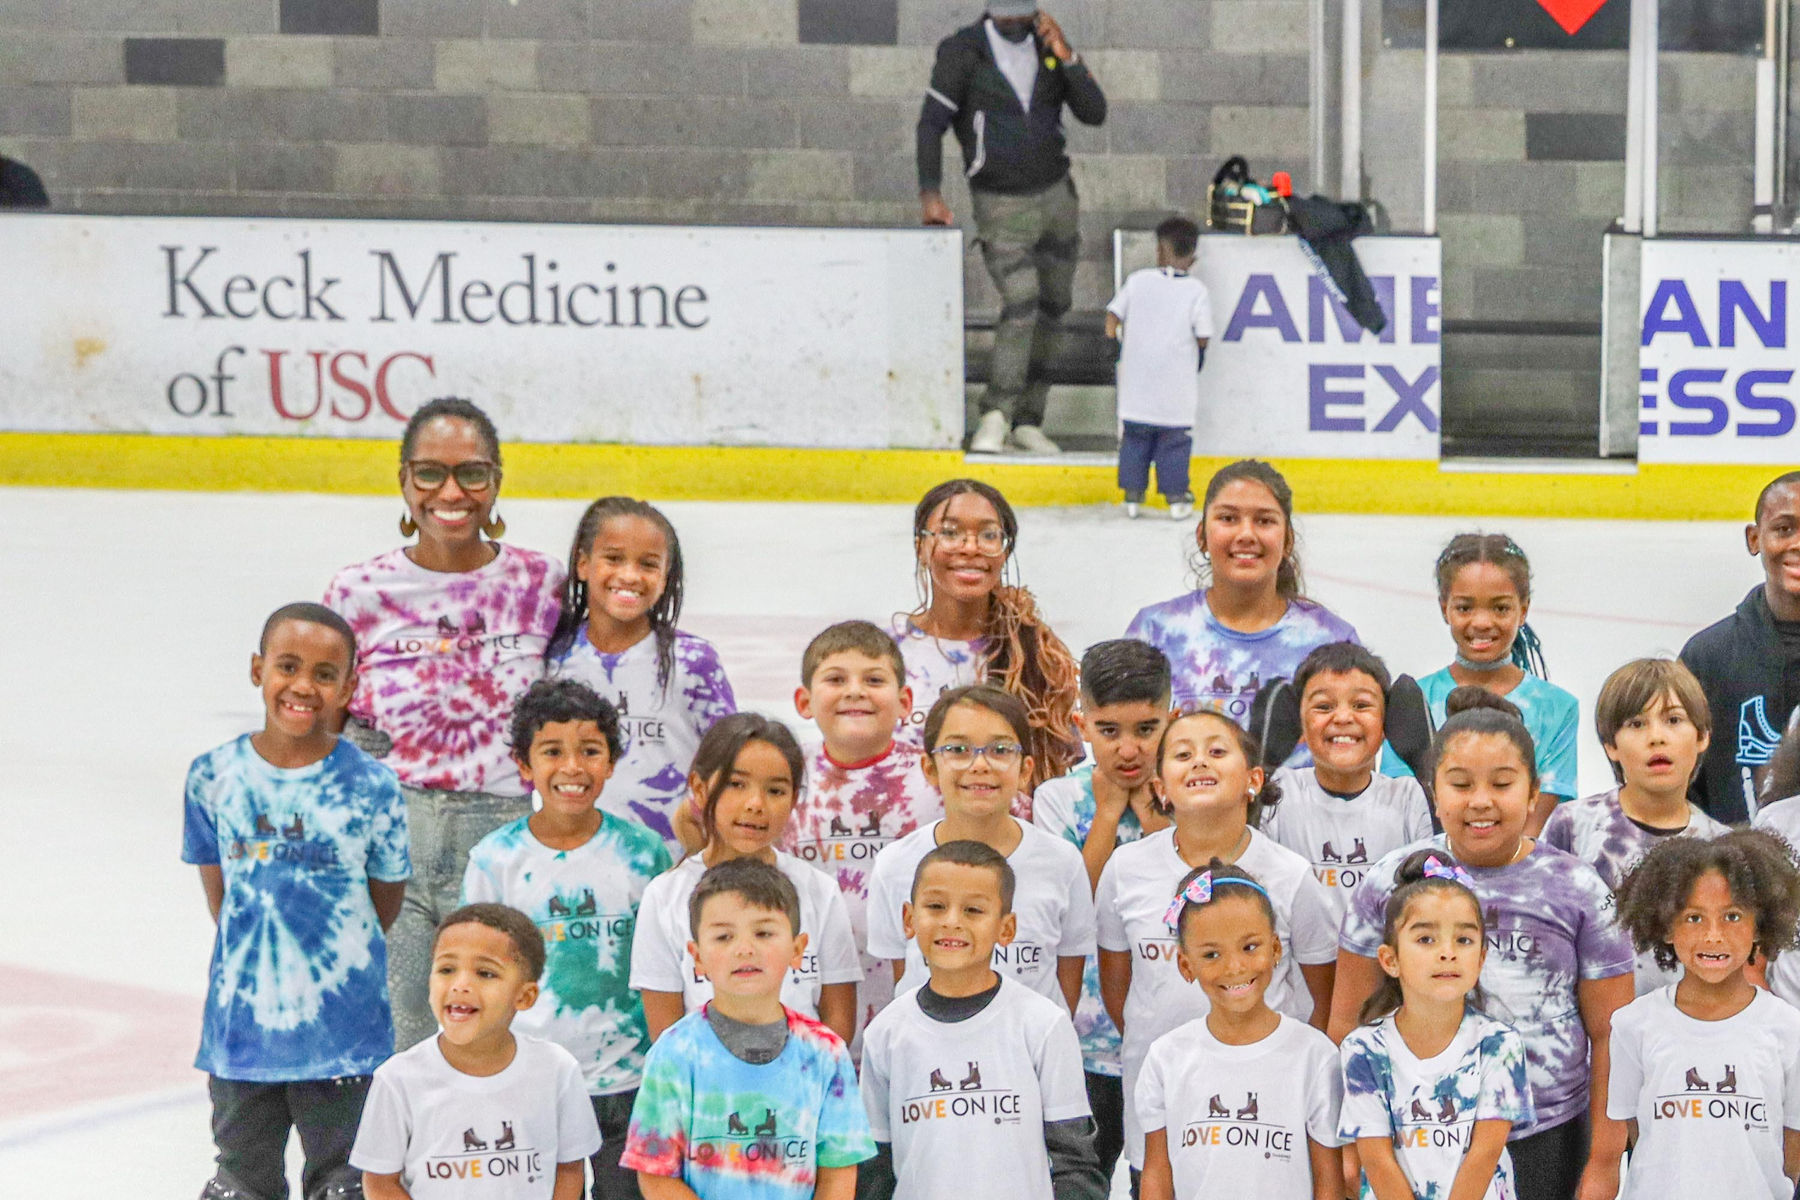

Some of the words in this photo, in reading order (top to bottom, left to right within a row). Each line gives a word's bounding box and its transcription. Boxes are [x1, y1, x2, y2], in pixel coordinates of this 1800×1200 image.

[158, 245, 346, 321] Keck
[369, 250, 710, 330] Medicine
[1641, 278, 1788, 349] AN
[166, 345, 245, 419] of
[260, 348, 437, 422] USC
[1308, 364, 1439, 433] EX
[490, 633, 521, 650] ICE
[637, 721, 665, 739] ICE
[794, 841, 847, 863] LOVE
[850, 842, 885, 861] ON
[569, 918, 600, 940] ON
[607, 917, 634, 938] ICE
[1015, 945, 1043, 965] ICE
[1509, 934, 1543, 954] ICE
[902, 1099, 947, 1124] LOVE
[951, 1097, 986, 1116] ON
[993, 1095, 1021, 1114] ICE
[1654, 1098, 1703, 1120] LOVE
[1708, 1099, 1741, 1119] ON
[1181, 1126, 1221, 1148] LOVE
[1226, 1126, 1258, 1146] ON
[1264, 1128, 1294, 1152] ICE
[1433, 1126, 1461, 1147] ON
[688, 1141, 742, 1162] LOVE
[745, 1142, 777, 1162] ON
[782, 1139, 809, 1161] ICE
[426, 1159, 483, 1179] LOVE
[487, 1157, 519, 1177] ON
